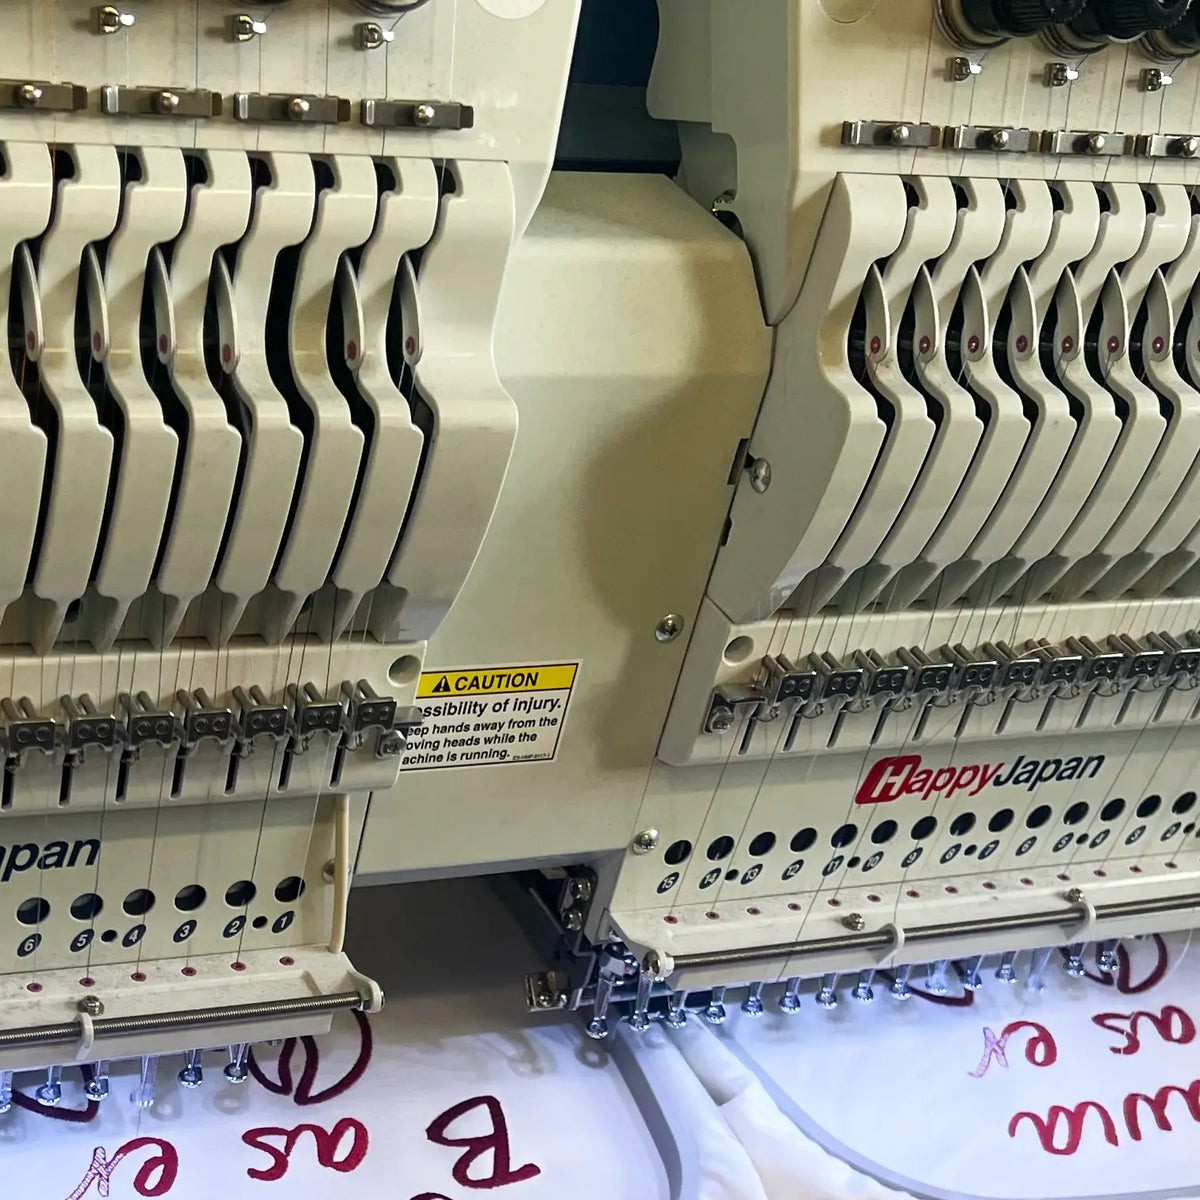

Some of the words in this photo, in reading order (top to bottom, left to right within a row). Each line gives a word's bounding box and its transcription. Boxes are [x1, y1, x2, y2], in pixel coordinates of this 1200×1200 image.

[455, 672, 539, 691] CAUTION
[418, 701, 488, 718] ssibility
[492, 698, 510, 713] of
[513, 697, 561, 714] injury.
[408, 726, 429, 737] eep
[432, 722, 470, 735] hands
[473, 720, 504, 733] away
[508, 718, 536, 729] from
[538, 716, 558, 727] the
[406, 739, 440, 751] oving
[443, 736, 480, 748] heads
[484, 733, 515, 745] while
[518, 732, 538, 743] the
[402, 753, 444, 765] achine
[446, 751, 458, 762] is
[460, 748, 510, 761] running.
[855, 754, 1105, 804] HappyJapan
